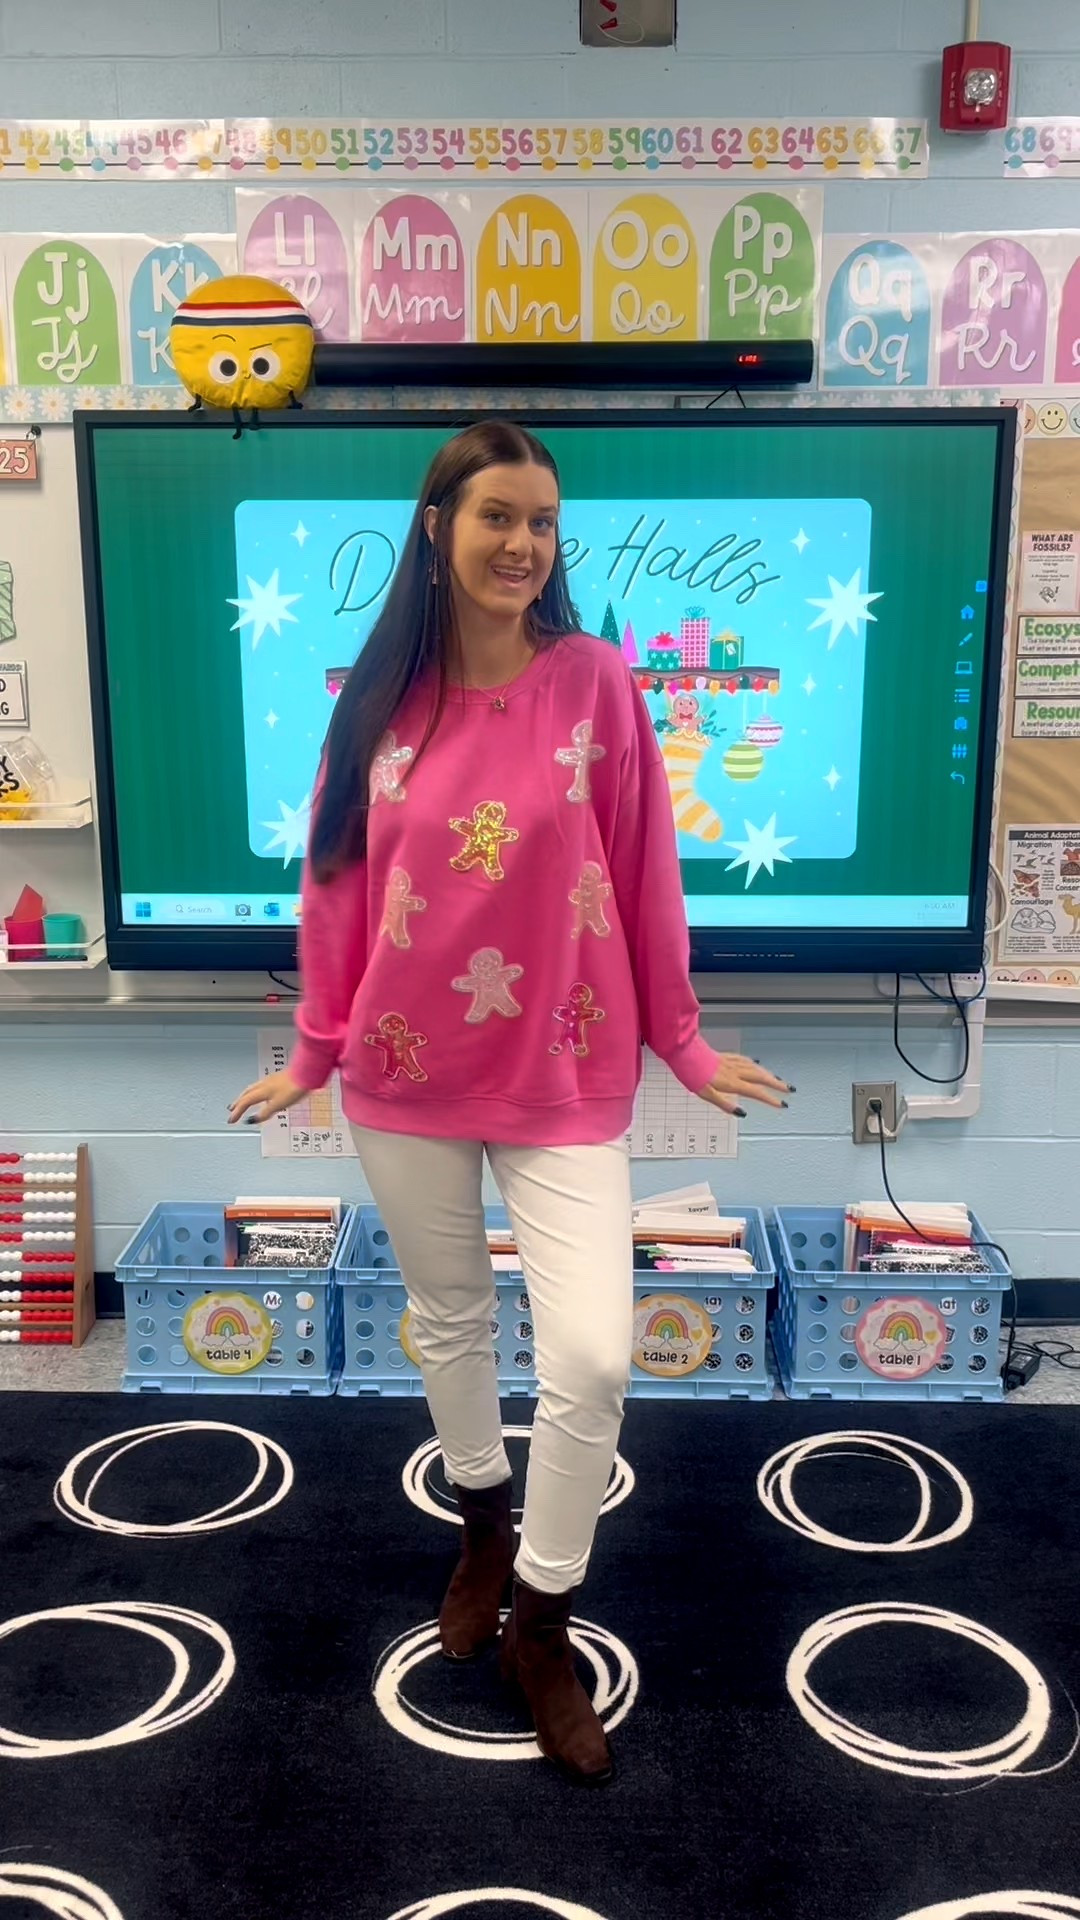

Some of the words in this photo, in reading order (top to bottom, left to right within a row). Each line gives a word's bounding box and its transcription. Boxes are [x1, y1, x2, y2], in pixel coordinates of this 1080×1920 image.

[0, 129, 11, 155] 1
[19, 129, 50, 155] 42
[55, 129, 85, 155] 43
[120, 130, 152, 155] 45
[156, 129, 187, 154] 46
[295, 128, 327, 155] 50
[331, 128, 359, 155] 51
[364, 128, 394, 155] 52
[397, 127, 429, 154] 53
[433, 128, 465, 155] 54
[469, 128, 500, 154] 55
[502, 128, 533, 154] 56
[536, 128, 567, 154] 57
[573, 128, 604, 155] 58
[608, 127, 640, 154] 59
[642, 127, 673, 154] 60
[676, 126, 704, 153] 61
[711, 127, 742, 154] 62
[748, 127, 779, 153] 63
[782, 127, 815, 154] 64
[816, 127, 849, 154] 65
[853, 127, 885, 154] 66
[890, 127, 921, 154] 67
[1005, 126, 1036, 152] 68
[1040, 126, 1071, 152] 69
[275, 212, 314, 266] Ll
[373, 216, 458, 271] Mm
[497, 212, 562, 266] Nn
[603, 210, 689, 270] Oo
[734, 205, 792, 274] Pp
[37, 252, 90, 324] Jj
[364, 283, 463, 325] Mm
[610, 281, 685, 334] Oo
[724, 268, 801, 335] Pp
[850, 253, 912, 322] Qq
[970, 255, 1026, 309] Rr
[485, 284, 580, 336] Nn
[31, 316, 98, 383] Jj
[839, 315, 912, 384] Qq
[957, 321, 1036, 371] Rr
[0, 446, 30, 474] 25
[607, 514, 782, 604] Halls
[1031, 534, 1055, 542] WHAT
[1057, 534, 1074, 542] ARE
[1032, 543, 1071, 552] FOSSILS?
[1024, 617, 1080, 641] Ecosys
[1018, 660, 1080, 681] Compet
[1024, 831, 1049, 839] Animal
[1010, 898, 1054, 906] Camouflage
[206, 1349, 240, 1360] table
[244, 1349, 252, 1360] 4
[643, 1350, 678, 1363] table
[681, 1353, 688, 1364] 2
[879, 1354, 914, 1365] table
[917, 1355, 921, 1365] 1
